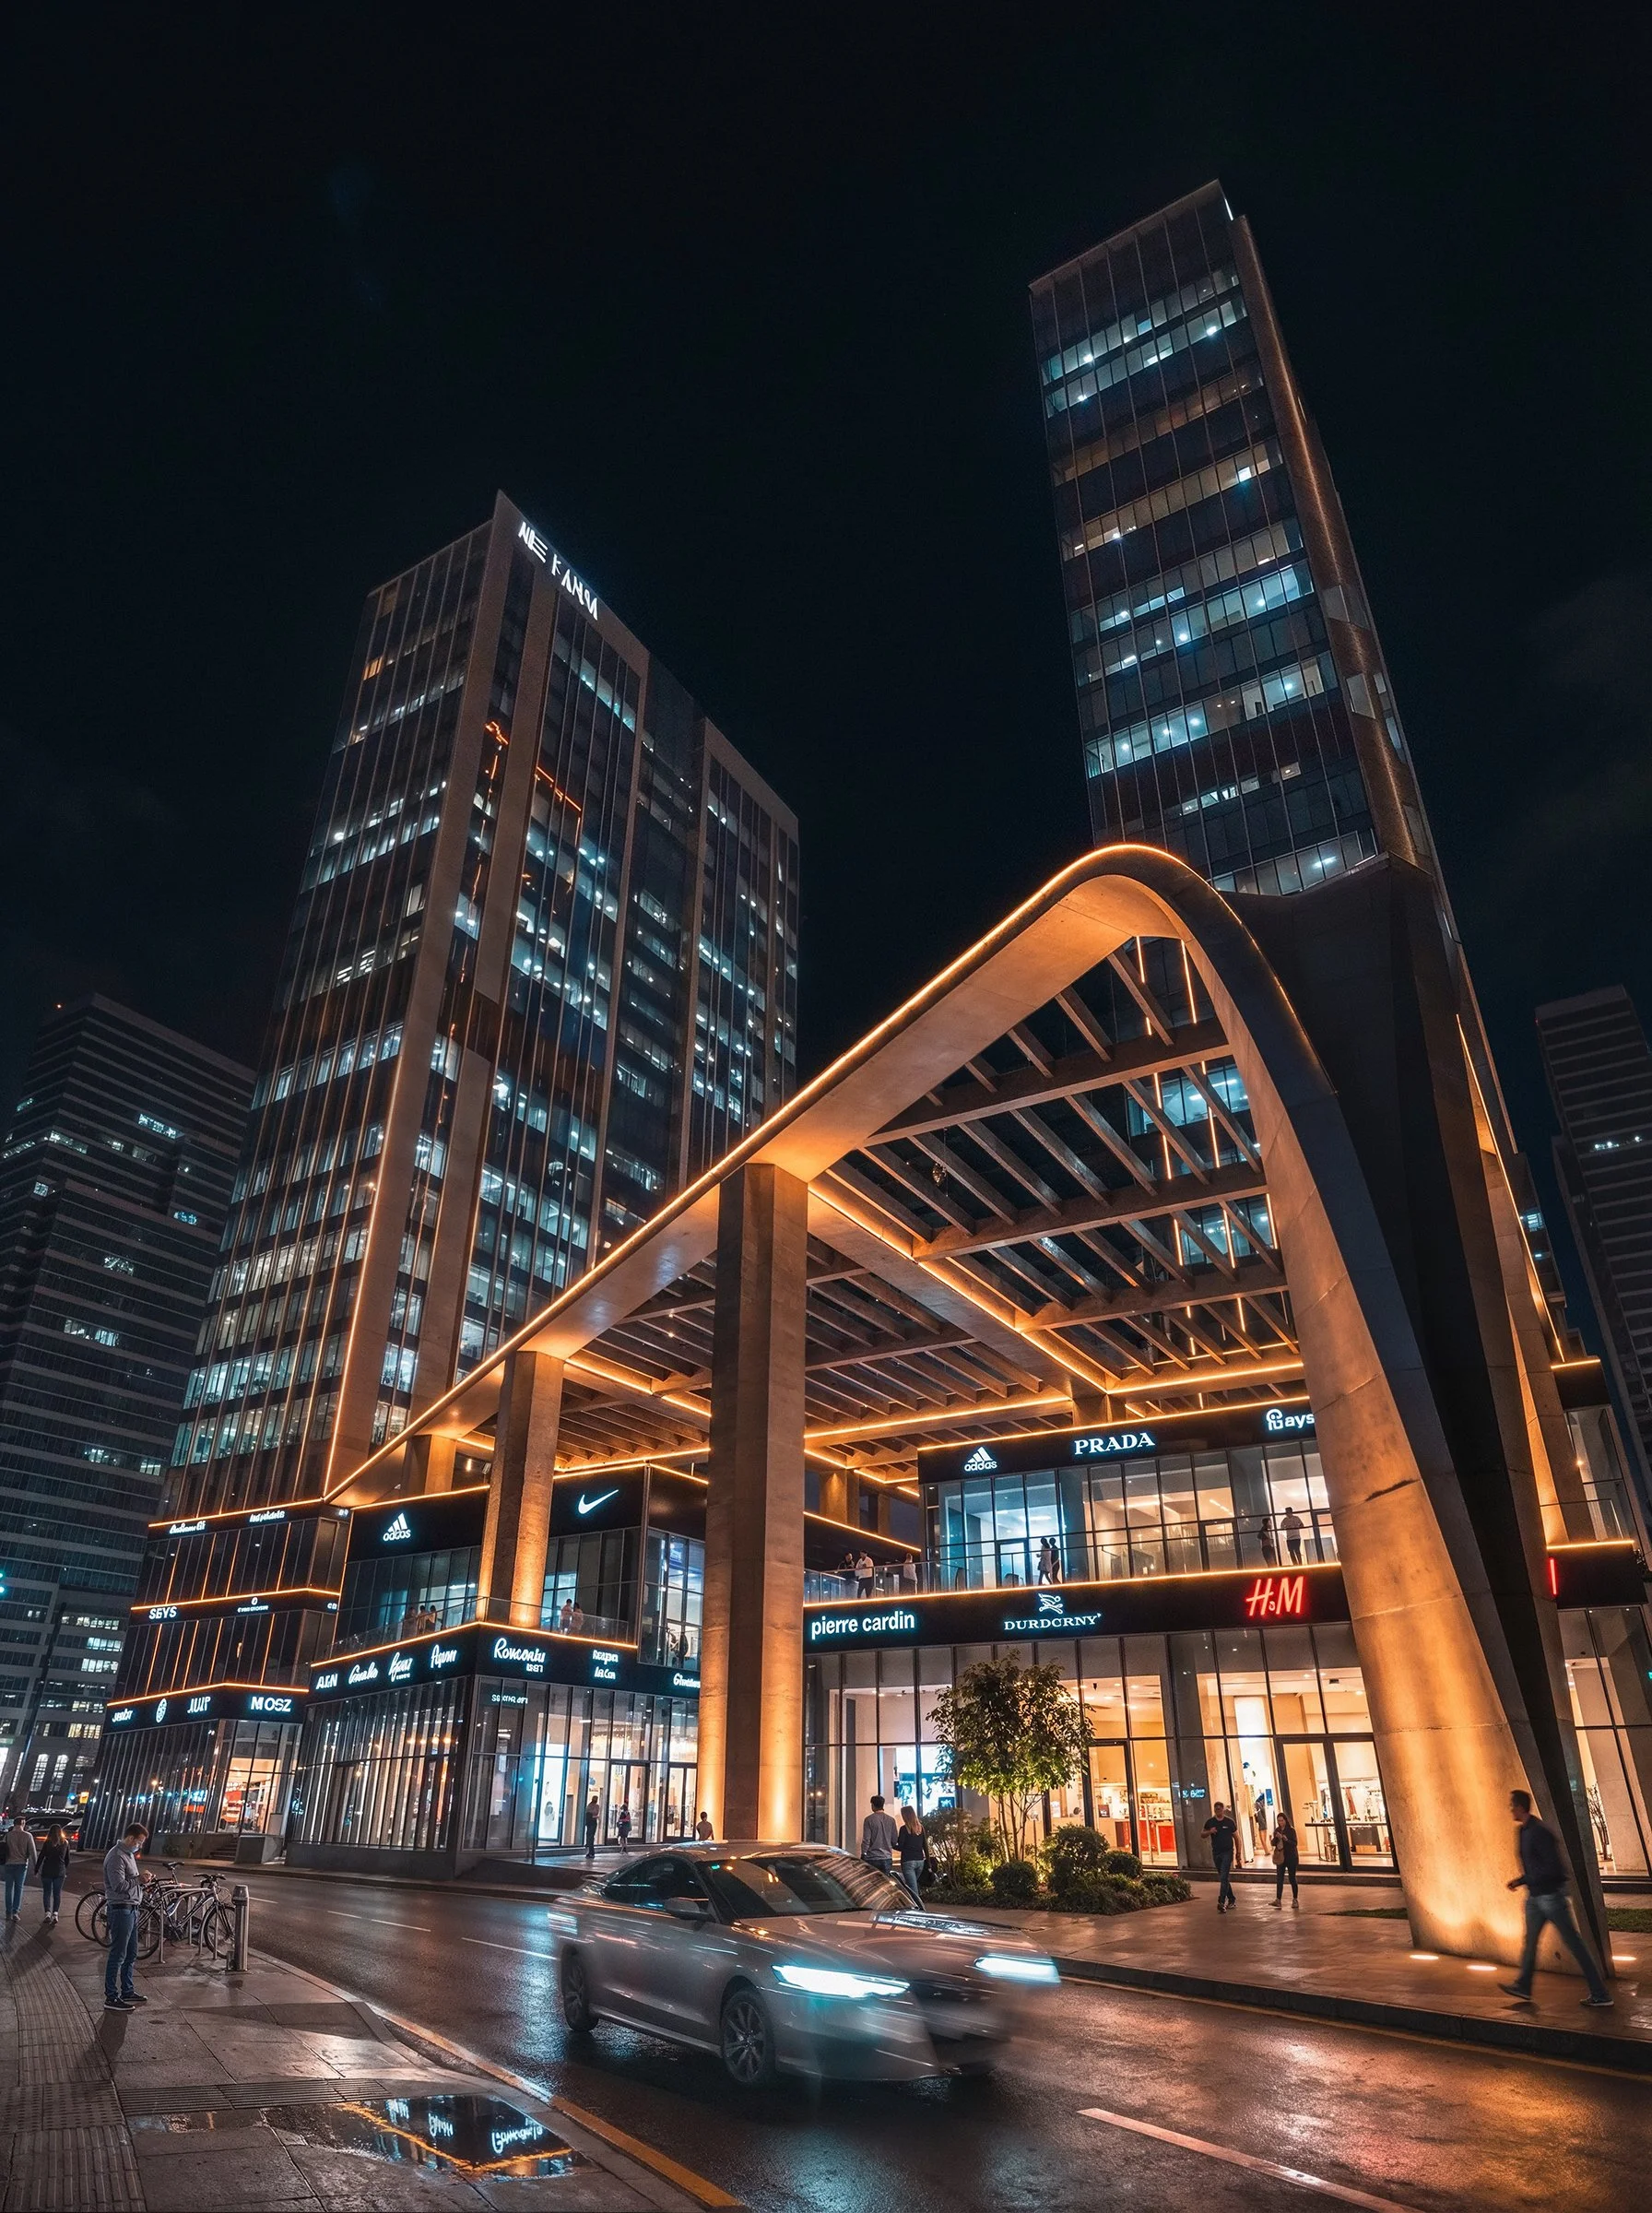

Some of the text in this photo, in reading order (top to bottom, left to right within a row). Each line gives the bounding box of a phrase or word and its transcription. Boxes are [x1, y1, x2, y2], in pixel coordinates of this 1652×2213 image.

[1074, 1432, 1156, 1455] PRADA
[811, 1610, 915, 1640] pierre cardin
